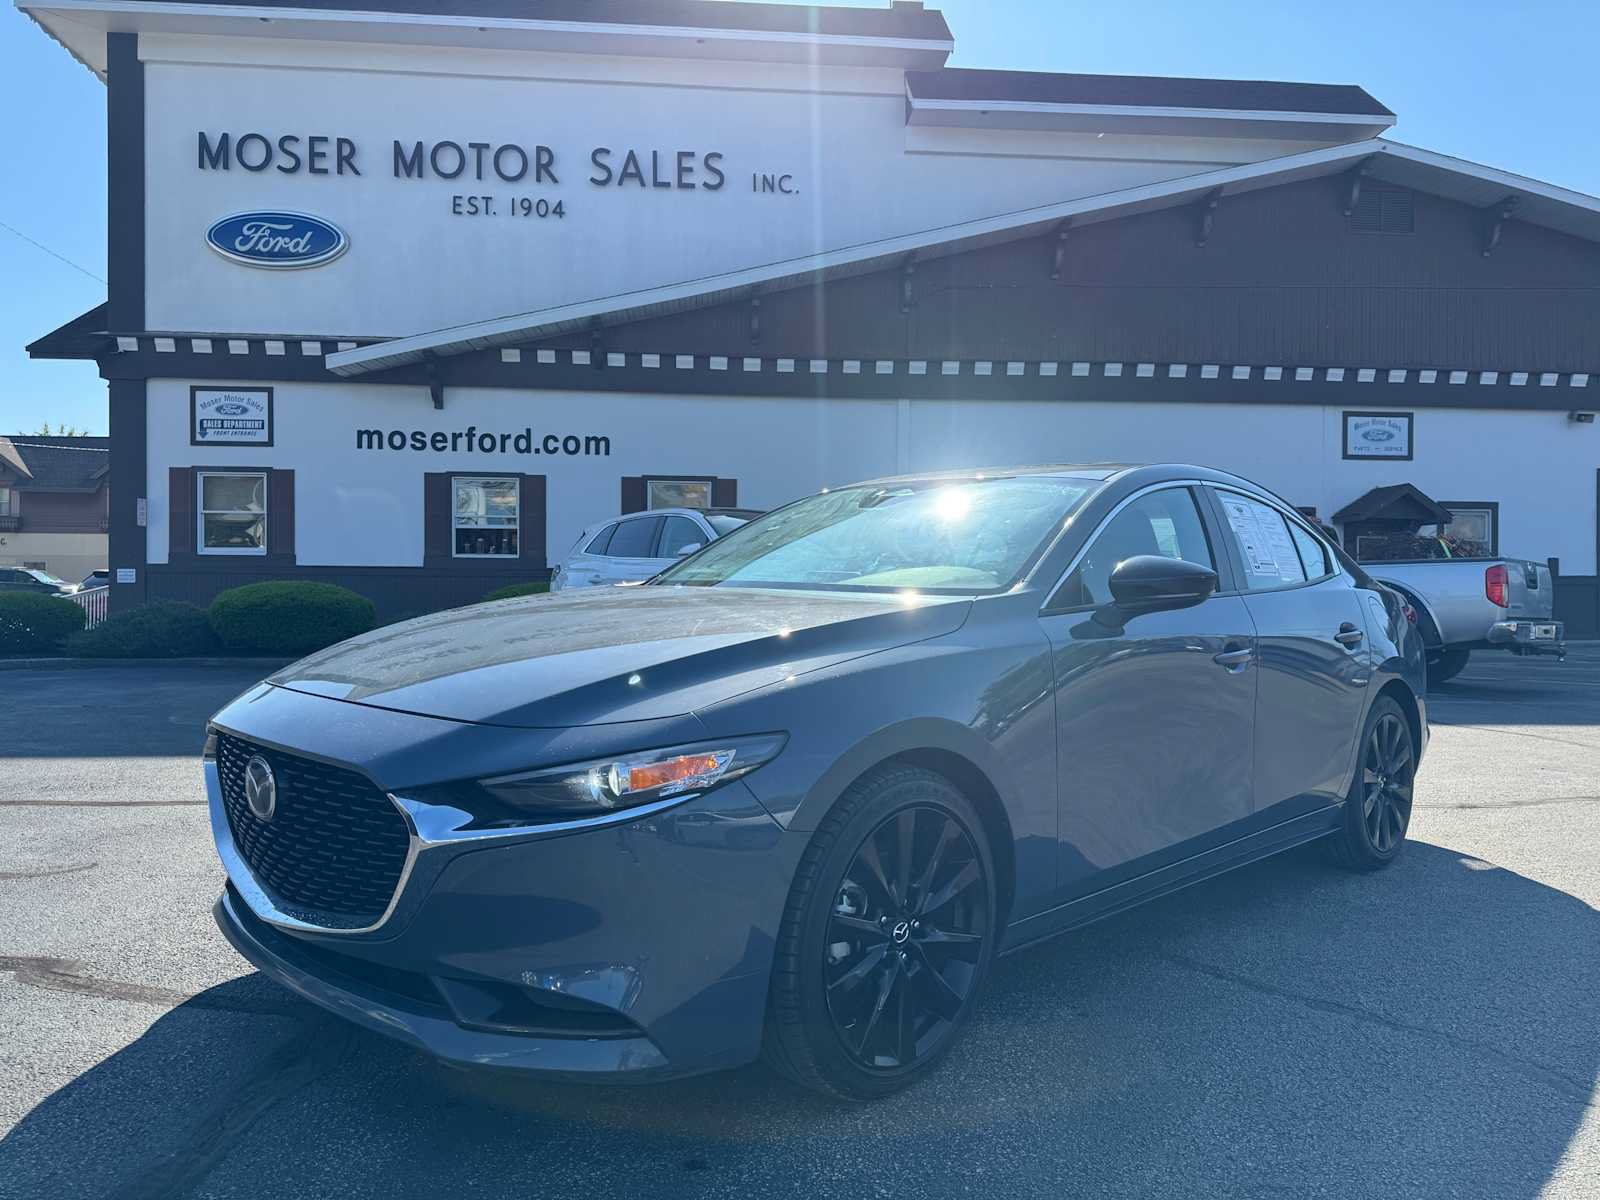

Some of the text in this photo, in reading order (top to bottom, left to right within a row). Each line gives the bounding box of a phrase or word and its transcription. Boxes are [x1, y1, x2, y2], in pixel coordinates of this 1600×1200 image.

[198, 131, 800, 195] MOSER MOTOR SALES INC.
[452, 195, 566, 219] EST. 1904
[234, 221, 313, 253] Ford
[223, 394, 245, 403] Motor
[203, 420, 263, 429] SALES DEPARTMENT
[356, 426, 611, 456] moserford.com
